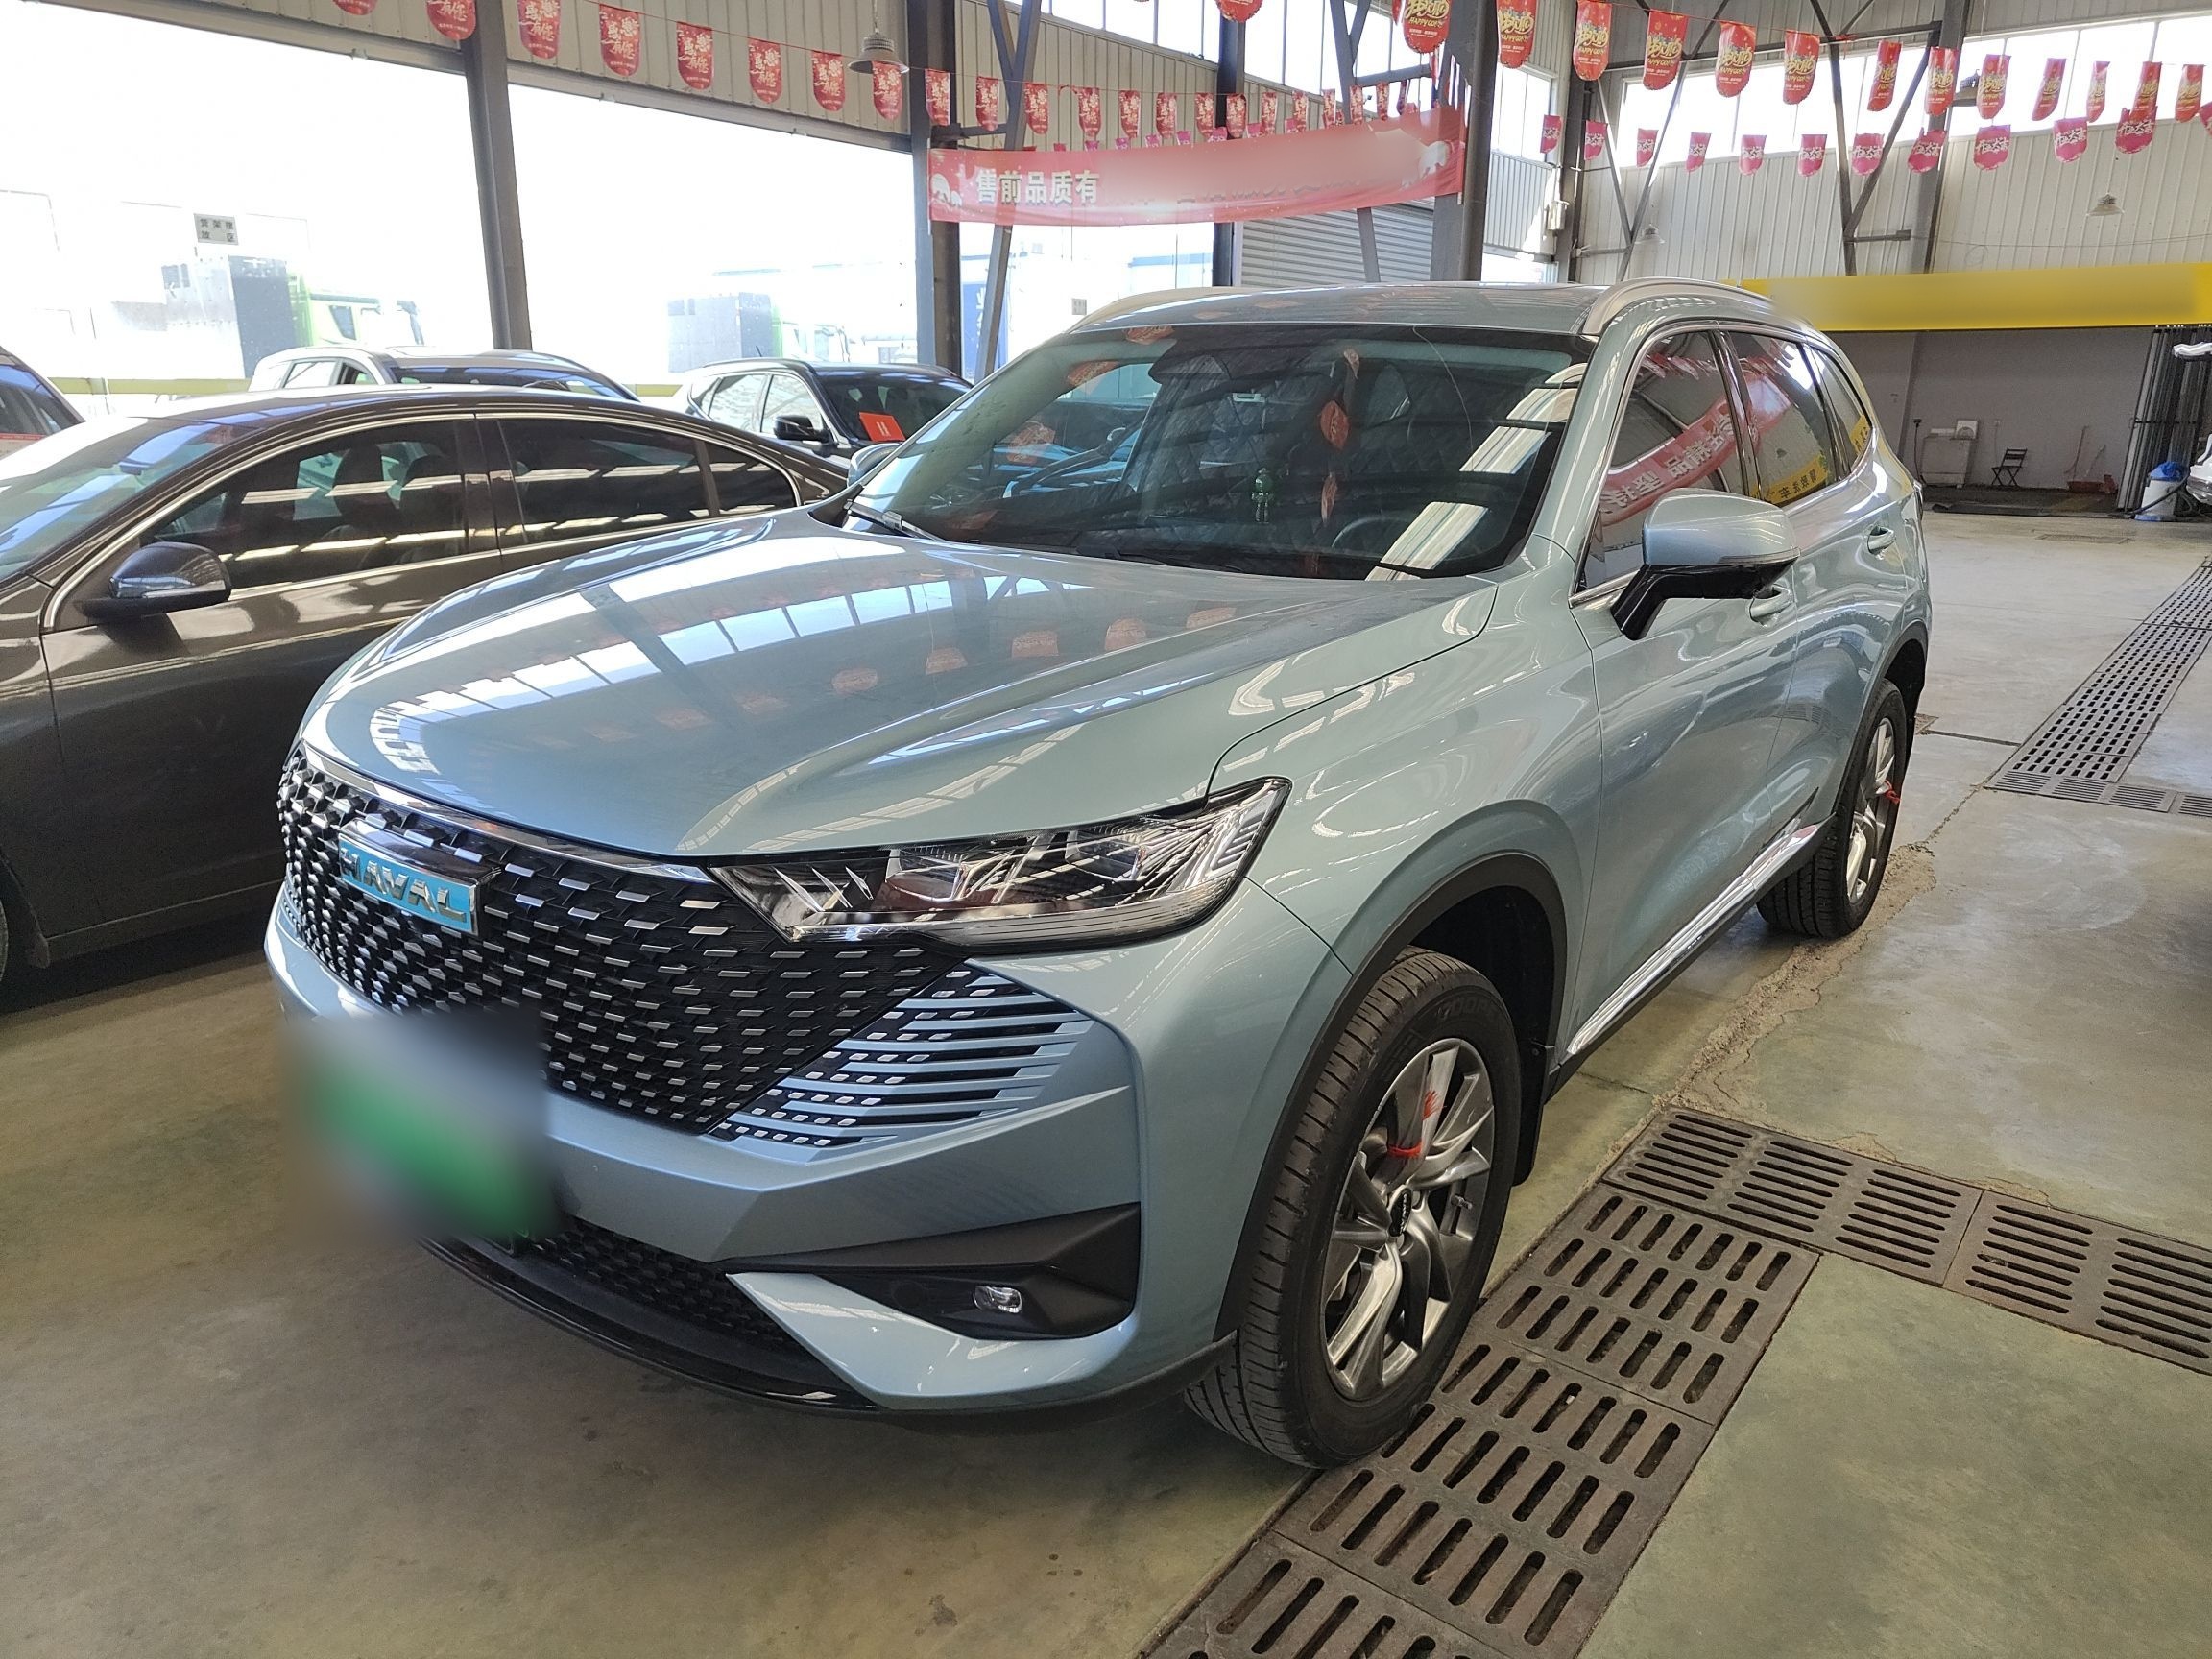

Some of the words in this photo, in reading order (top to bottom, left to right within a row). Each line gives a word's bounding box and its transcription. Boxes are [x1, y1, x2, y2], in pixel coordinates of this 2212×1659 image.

[975, 168, 1099, 205] 售前品质有
[339, 847, 467, 923] HAVAL
